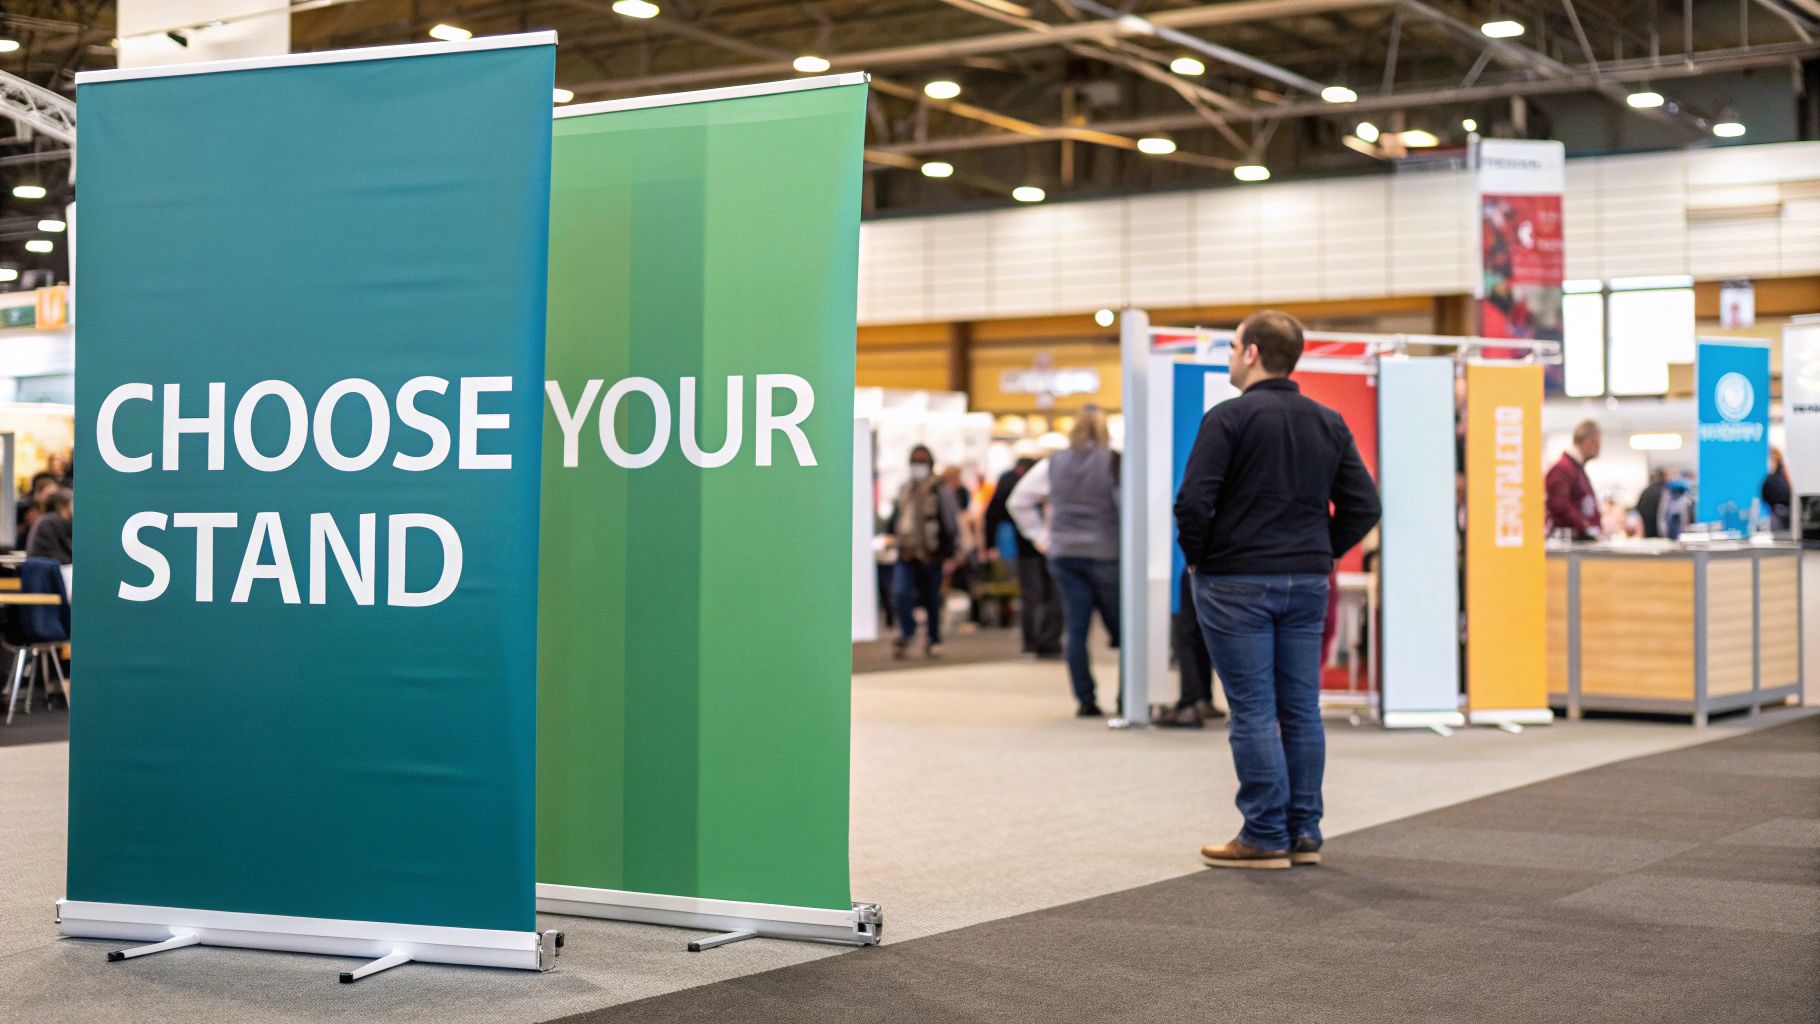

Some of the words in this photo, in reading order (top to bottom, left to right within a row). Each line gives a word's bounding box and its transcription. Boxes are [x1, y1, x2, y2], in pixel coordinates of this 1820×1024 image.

[96, 375, 513, 473] CHOOSE
[545, 373, 818, 469] YOUR
[118, 511, 463, 607] STAND
